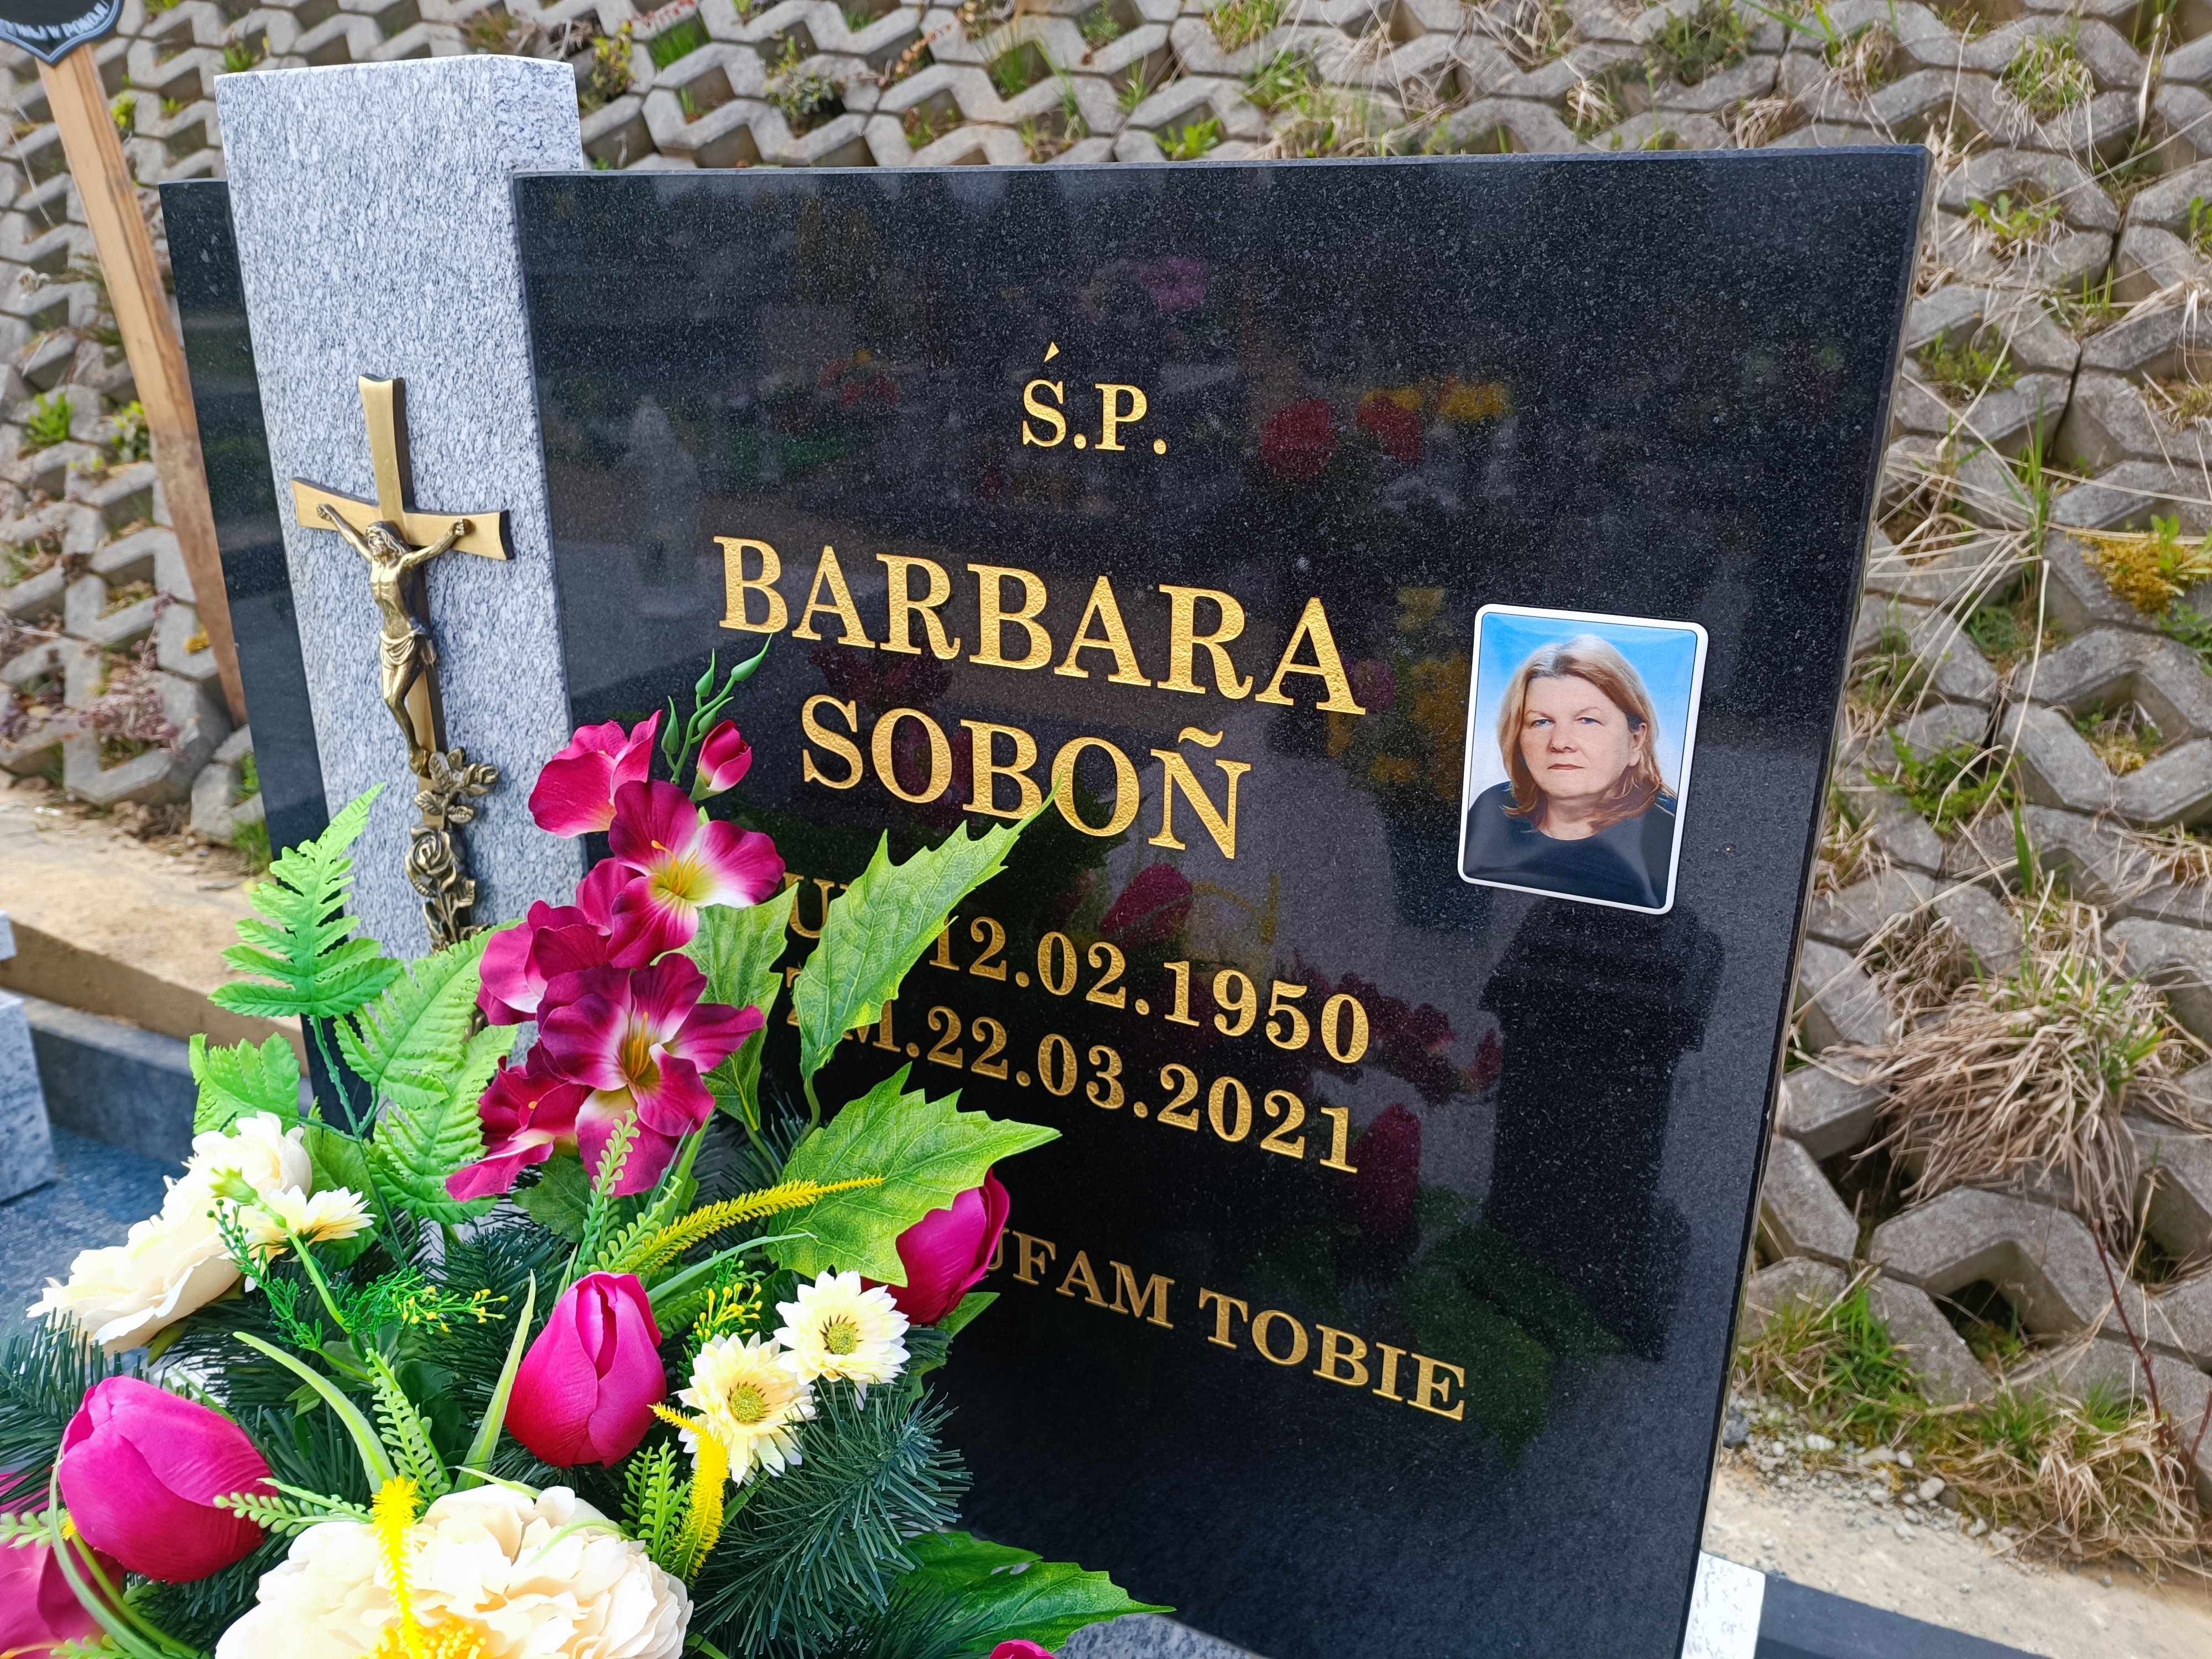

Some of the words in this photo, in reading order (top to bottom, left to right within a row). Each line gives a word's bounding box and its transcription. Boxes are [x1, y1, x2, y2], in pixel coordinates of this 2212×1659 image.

[1022, 341, 1167, 455] Ś.P.
[713, 535, 1366, 715] BARBARA
[1198, 1287, 1465, 1422] TOBIE
